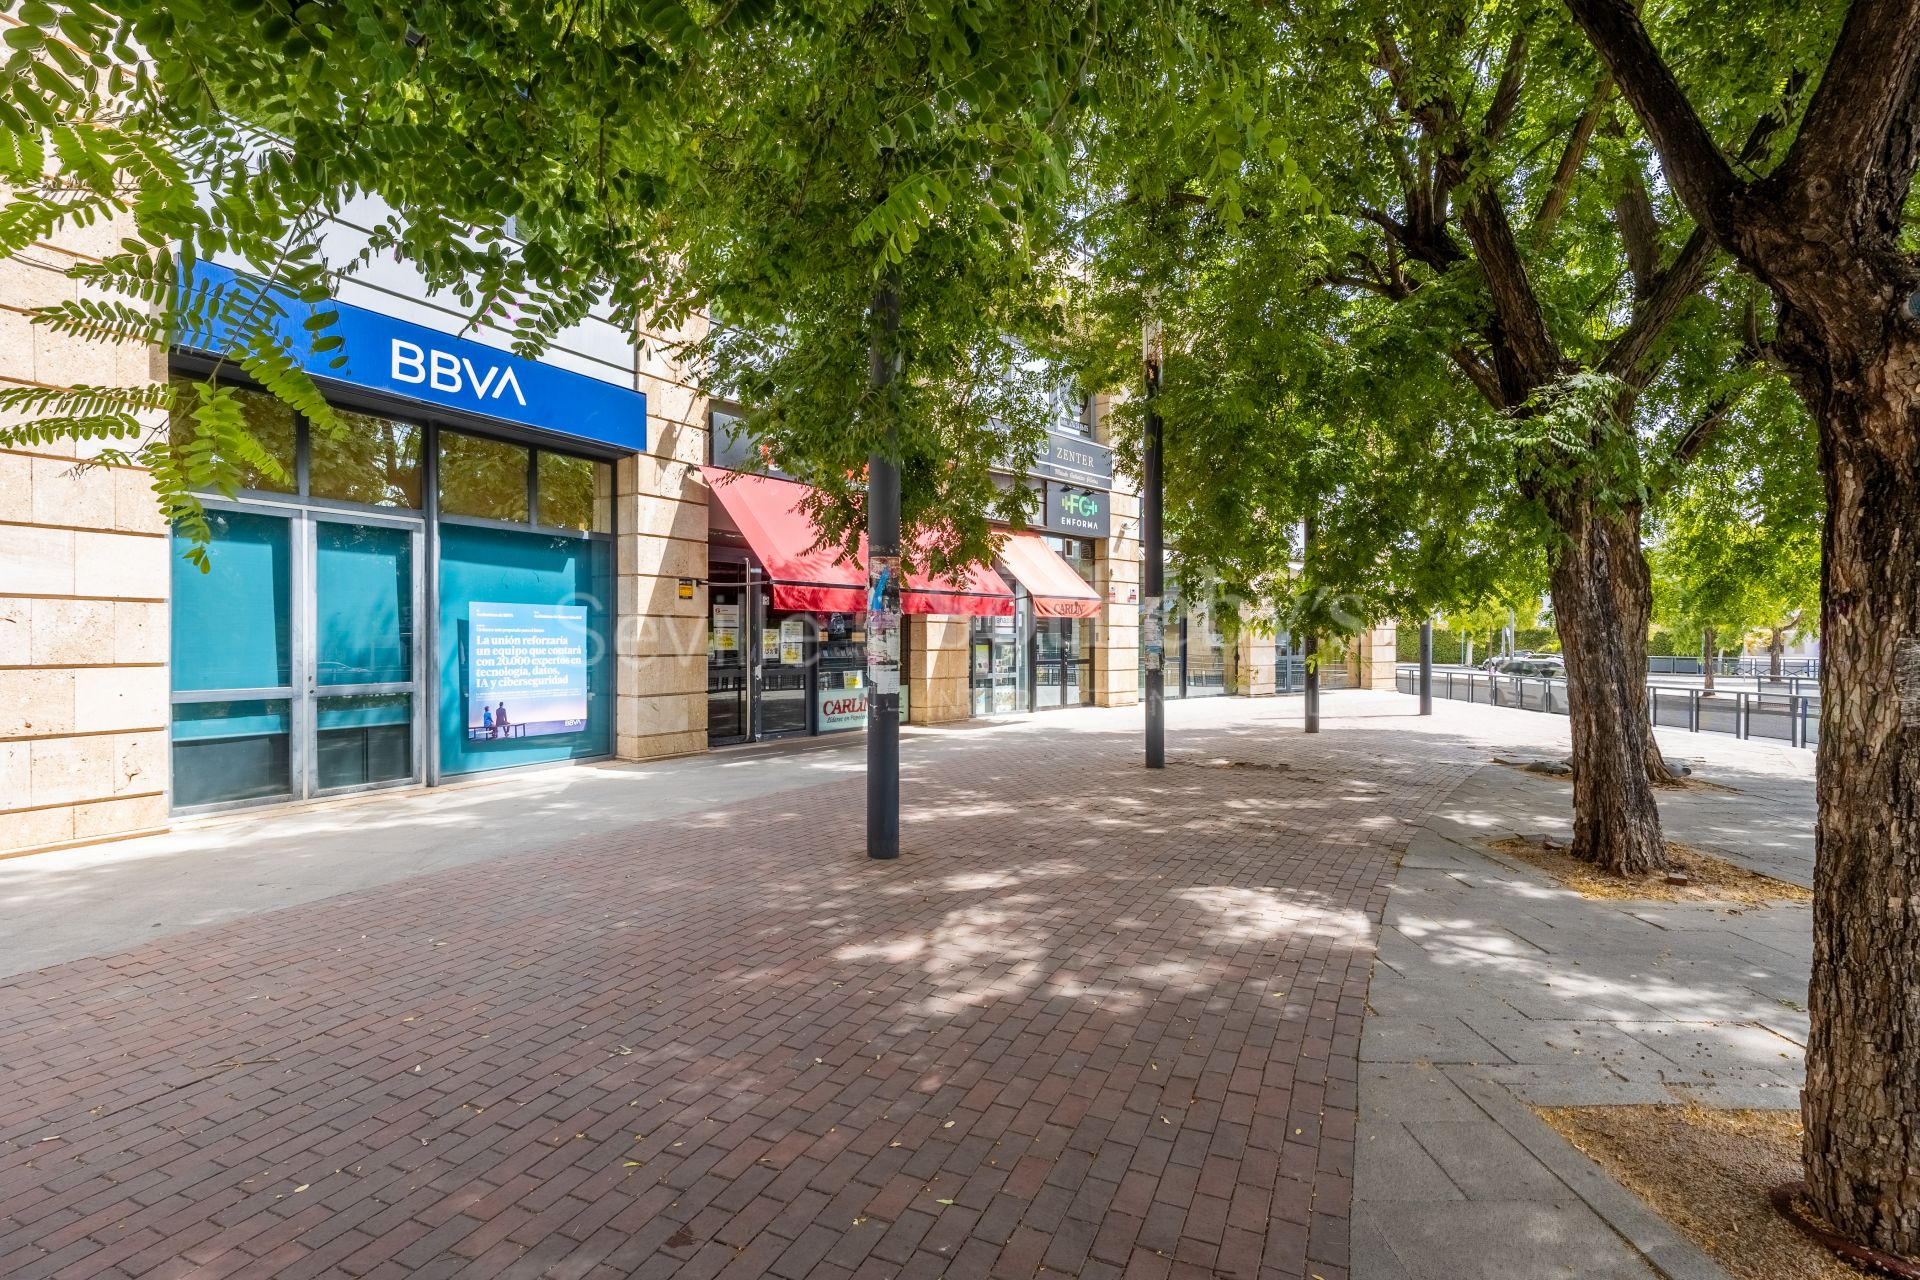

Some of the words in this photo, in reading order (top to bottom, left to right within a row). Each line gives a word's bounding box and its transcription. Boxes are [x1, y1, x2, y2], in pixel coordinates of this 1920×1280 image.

[391, 338, 527, 406] BBVA
[1056, 447, 1095, 468] ZENTER
[1061, 516, 1099, 530] ENFORMA
[476, 635, 490, 645] La
[491, 635, 521, 645] unión
[522, 635, 569, 646] reforzaría
[476, 647, 491, 656] un
[492, 646, 528, 658] equipo
[529, 647, 547, 657] que
[547, 645, 582, 656] contará
[476, 658, 495, 667] con
[496, 656, 530, 666] 20.000
[531, 656, 570, 668] expertos
[571, 657, 582, 665] en
[476, 666, 531, 679] tecnología,
[532, 665, 560, 676] datos,
[476, 678, 489, 688] IA
[490, 680, 497, 690] y
[498, 675, 569, 688] ciberseguridad
